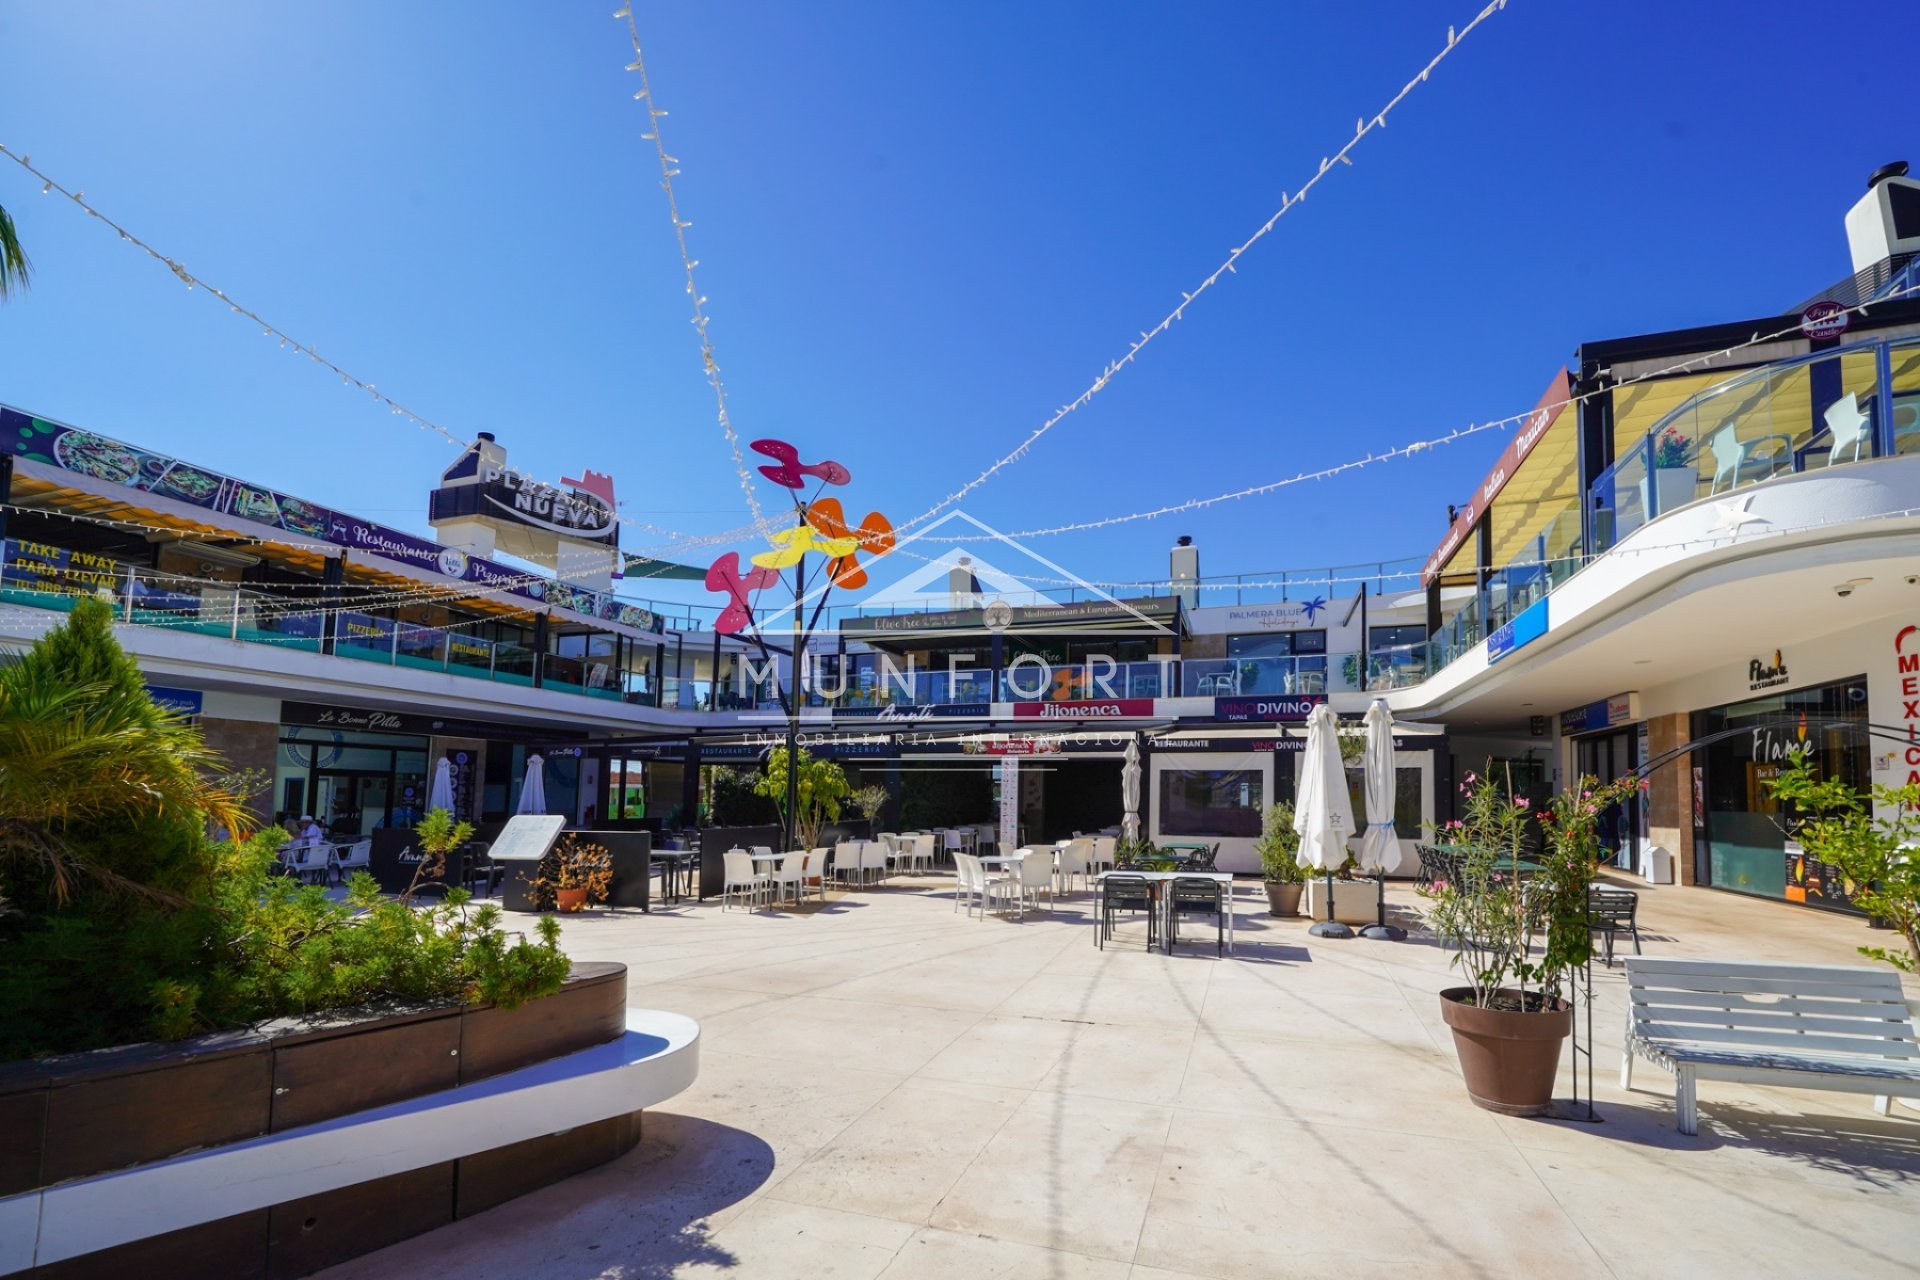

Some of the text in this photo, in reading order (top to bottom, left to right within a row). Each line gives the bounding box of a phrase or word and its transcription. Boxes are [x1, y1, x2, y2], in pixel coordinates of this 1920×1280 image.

[1516, 407, 1550, 459] Mexican
[485, 466, 570, 503] PLAZA
[514, 493, 599, 528] NUEVA
[18, 540, 117, 570] TAKE AWAY
[15, 558, 117, 588] PARA LLEVAR
[1023, 606, 1079, 618] Mediterranean
[1229, 608, 1301, 620] PALMERA BLUE
[876, 702, 937, 721] Avanti
[1040, 703, 1122, 719] Jijonenca
[1154, 740, 1209, 748] RESTAURANTE
[1752, 727, 1816, 764] Flame
